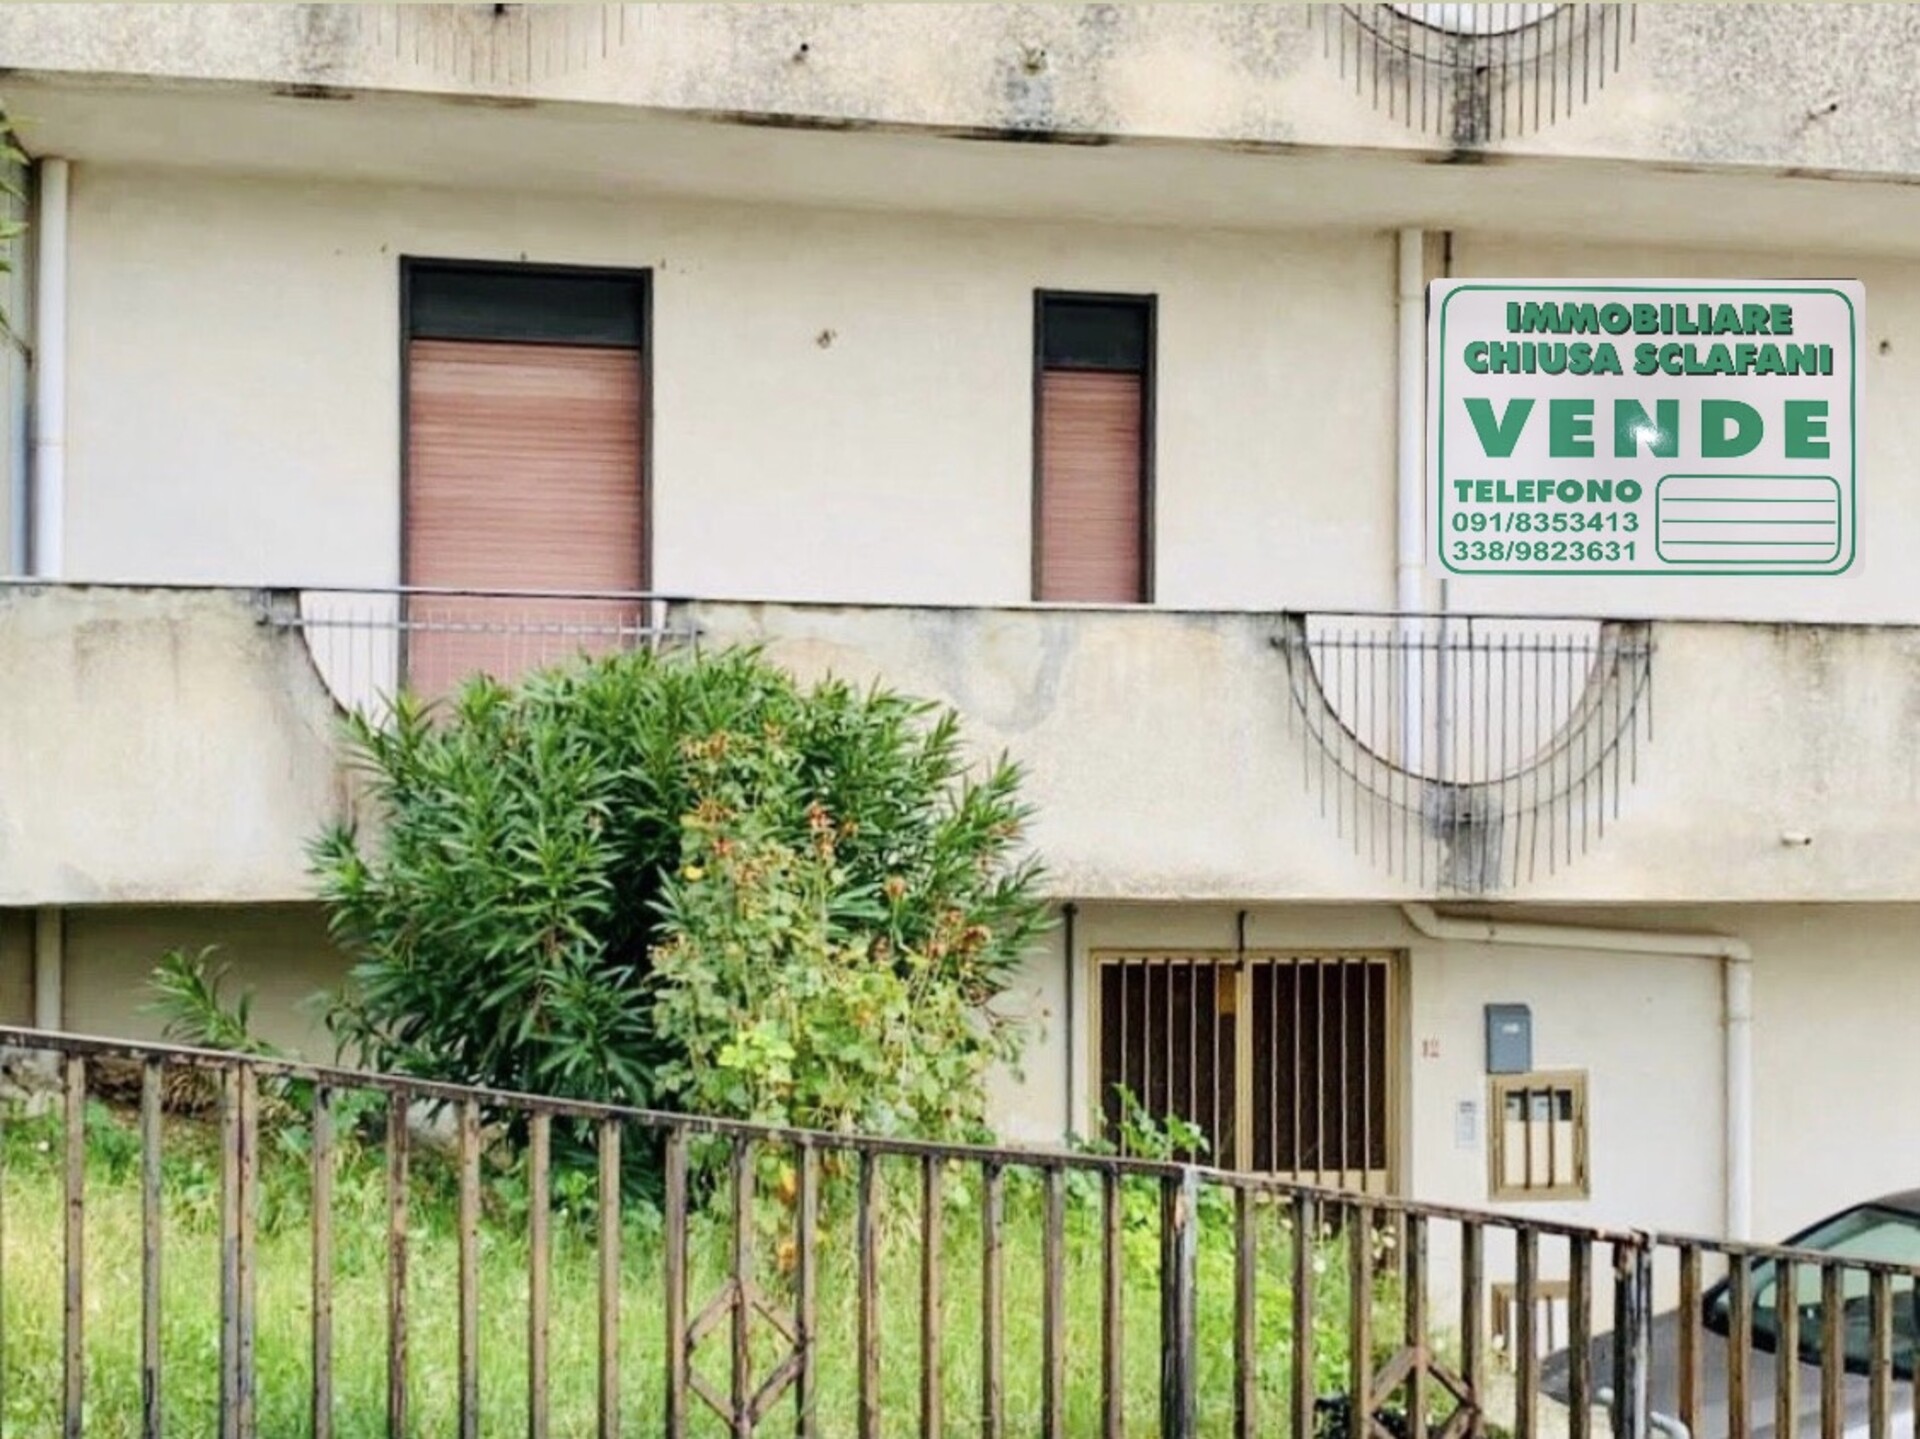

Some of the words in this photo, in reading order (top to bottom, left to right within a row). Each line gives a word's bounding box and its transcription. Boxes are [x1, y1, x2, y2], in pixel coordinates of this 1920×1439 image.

[1506, 301, 1793, 335] IMMOBILIARE
[1463, 340, 1623, 375] CHIUSA
[1633, 342, 1833, 375] SCLAFANI
[1462, 397, 1831, 459] VENDE
[1453, 478, 1642, 503] TELEFONO
[1452, 511, 1639, 533] 091/8353413
[1452, 540, 1636, 562] 338/9823631
